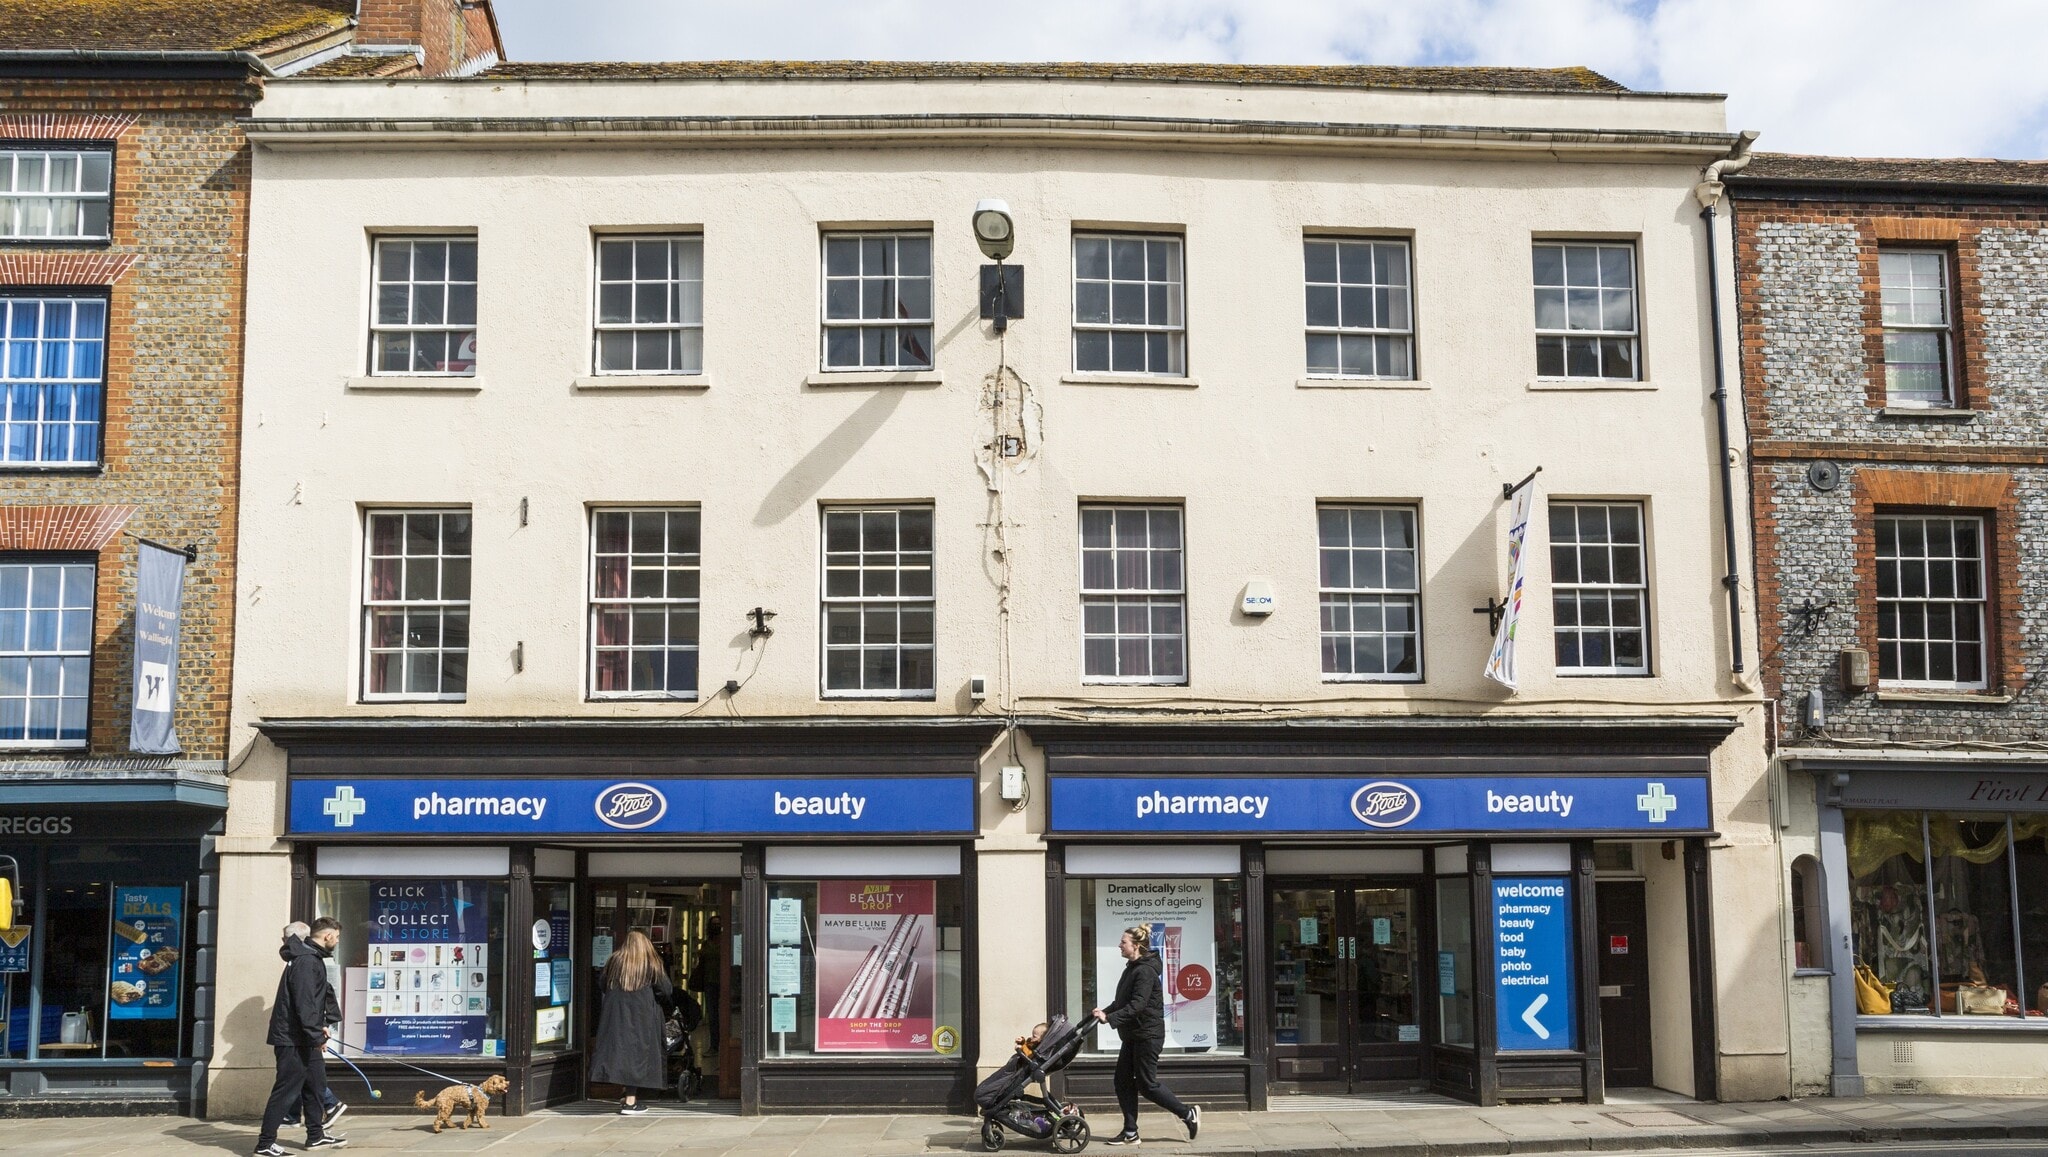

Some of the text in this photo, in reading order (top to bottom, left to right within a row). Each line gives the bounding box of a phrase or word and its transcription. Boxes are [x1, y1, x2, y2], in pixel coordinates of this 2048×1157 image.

[1968, 780, 2032, 802] First
[413, 792, 547, 820] pharmacy
[606, 792, 654, 818] Boots
[774, 792, 866, 820] beauty
[1136, 790, 1269, 818] pharmacy
[1362, 792, 1408, 817] Boots
[1487, 790, 1574, 818] beauty
[378, 887, 425, 897] CLICK
[1108, 883, 1201, 895] Dramatically slow
[1497, 884, 1564, 897] welcome
[124, 893, 148, 903] Tasty
[850, 894, 904, 903] BEAUTY
[1106, 898, 1123, 907] the
[1126, 897, 1152, 909] signs
[1154, 897, 1166, 907] of
[124, 903, 172, 915] DEALS
[378, 900, 429, 911] TODAY
[1499, 904, 1550, 915] pharmacy
[378, 914, 450, 925] COLLECT
[1500, 918, 1534, 929] beauty
[378, 928, 449, 939] IN STORE
[1500, 932, 1524, 942] food
[1500, 947, 1526, 958] baby
[1501, 961, 1532, 972] photo
[1187, 977, 1202, 986] 1/3
[1501, 975, 1548, 985] electrical
